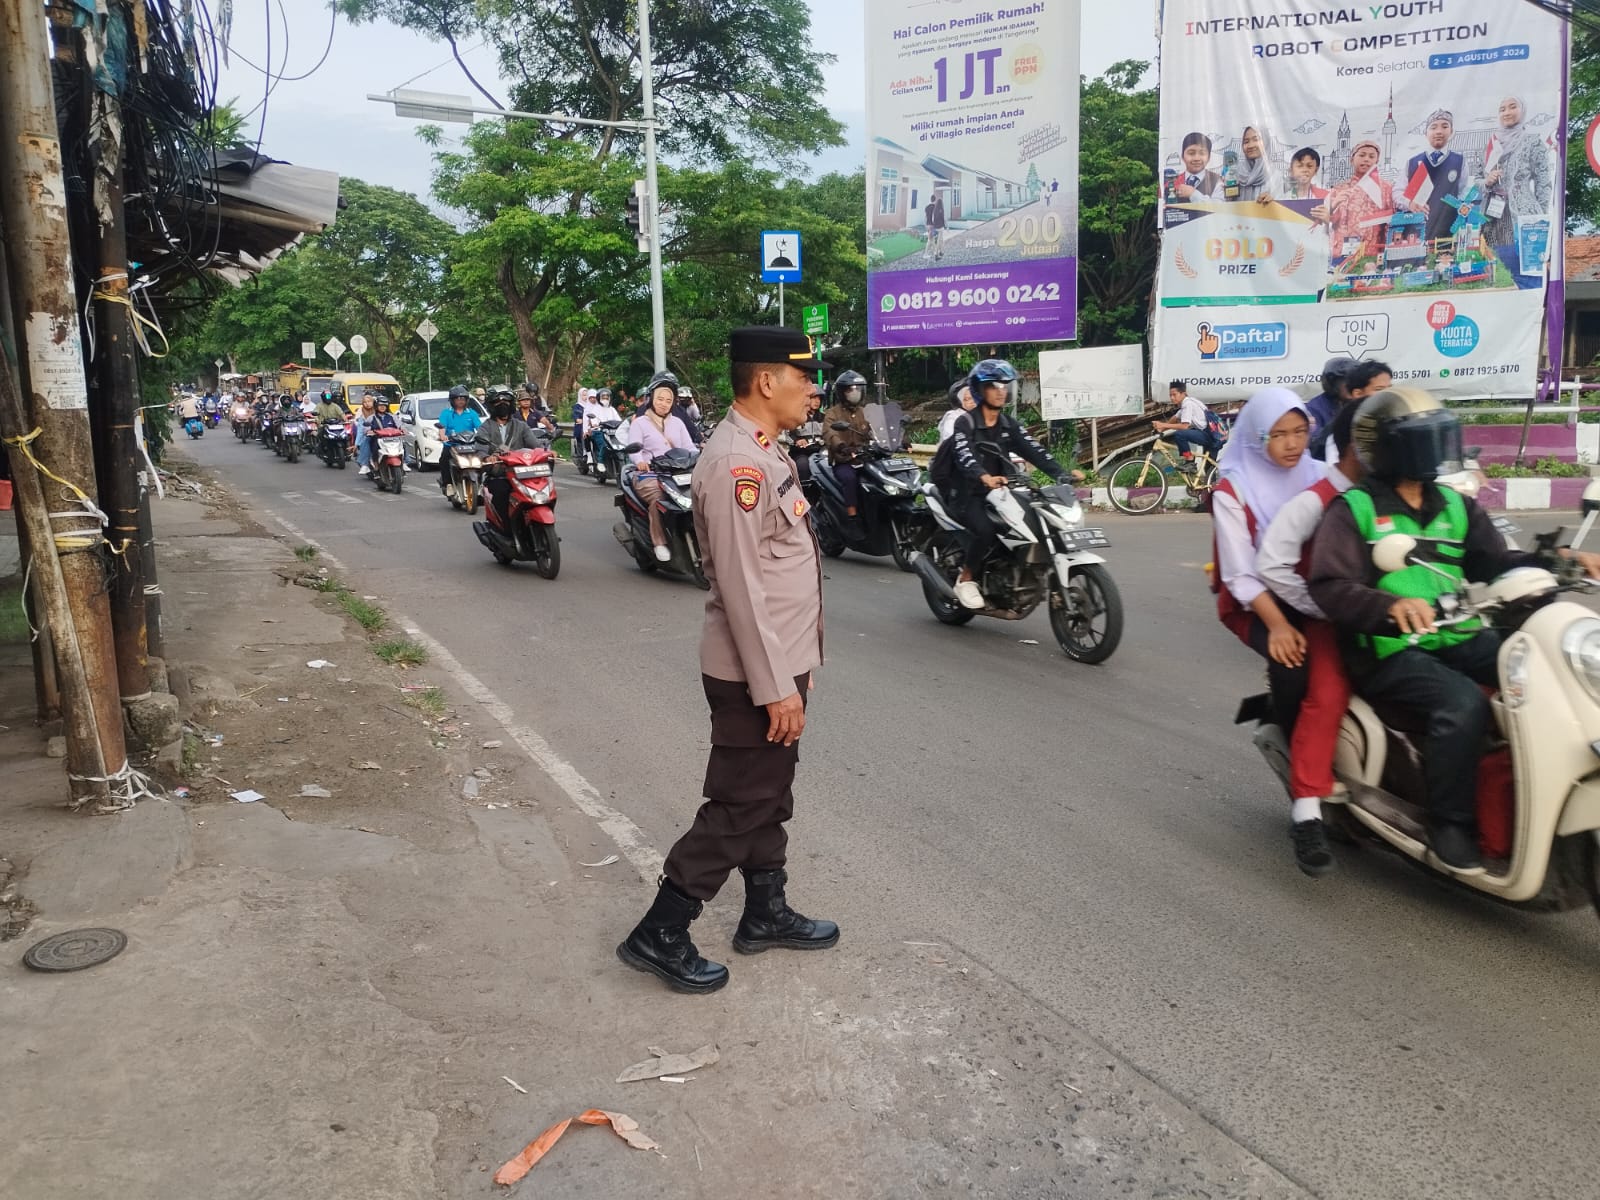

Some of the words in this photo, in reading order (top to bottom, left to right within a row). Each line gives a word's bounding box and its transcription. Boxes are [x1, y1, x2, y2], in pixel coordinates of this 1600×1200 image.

[893, 26, 911, 39] Hai
[914, 23, 946, 36] Calon
[949, 12, 994, 29] Pemilik
[997, 2, 1045, 20] Rumah!
[1186, 8, 1362, 35] INTERNATIONAL
[1369, 0, 1444, 20] YOUTH
[984, 26, 1007, 35] HUNIAN
[1009, 20, 1035, 29] IDAMAN
[1252, 41, 1323, 58] ROBOT
[1331, 22, 1488, 54] COMPETITION
[1014, 56, 1037, 67] FREE
[1336, 65, 1374, 77] Korea
[1377, 59, 1426, 73] Selatan,
[1457, 51, 1499, 64] AGUSTUS
[1503, 49, 1525, 57] 2024
[1014, 65, 1037, 76] PPN
[889, 79, 907, 89] Ada
[934, 57, 947, 102] 1
[892, 87, 913, 95] Cicilan
[914, 84, 932, 92] cuma
[910, 119, 934, 132] Miliki
[936, 116, 965, 128] rumah
[966, 112, 998, 125] impian
[1000, 108, 1025, 119] Anda
[919, 131, 928, 142] di
[930, 125, 963, 140] Villagio
[965, 121, 1015, 136] Residence!
[966, 238, 995, 249] Harga
[999, 211, 1062, 247] 200
[1205, 236, 1274, 260] GOLD
[1219, 264, 1256, 275] PRIZE
[926, 274, 954, 284] Hubungi
[955, 273, 973, 282] Kami
[899, 290, 943, 310] 0812
[947, 287, 1000, 307] 9600
[1006, 283, 1060, 304] 0242
[1341, 319, 1376, 333] JOIN
[1441, 326, 1473, 339] KUOTA
[1223, 329, 1282, 345] Daftar
[1347, 334, 1368, 347] US
[1440, 338, 1473, 348] TERBATAS
[1223, 346, 1268, 356] Sekarang
[1392, 370, 1409, 380] 935
[1411, 369, 1431, 379] 5701
[1454, 367, 1475, 377] 0812
[1477, 365, 1498, 375] 1925
[1500, 364, 1520, 374] 5170
[1173, 377, 1235, 386] INFORMASI
[1240, 376, 1272, 385] PPDB
[1276, 374, 1321, 385] 2025/20
